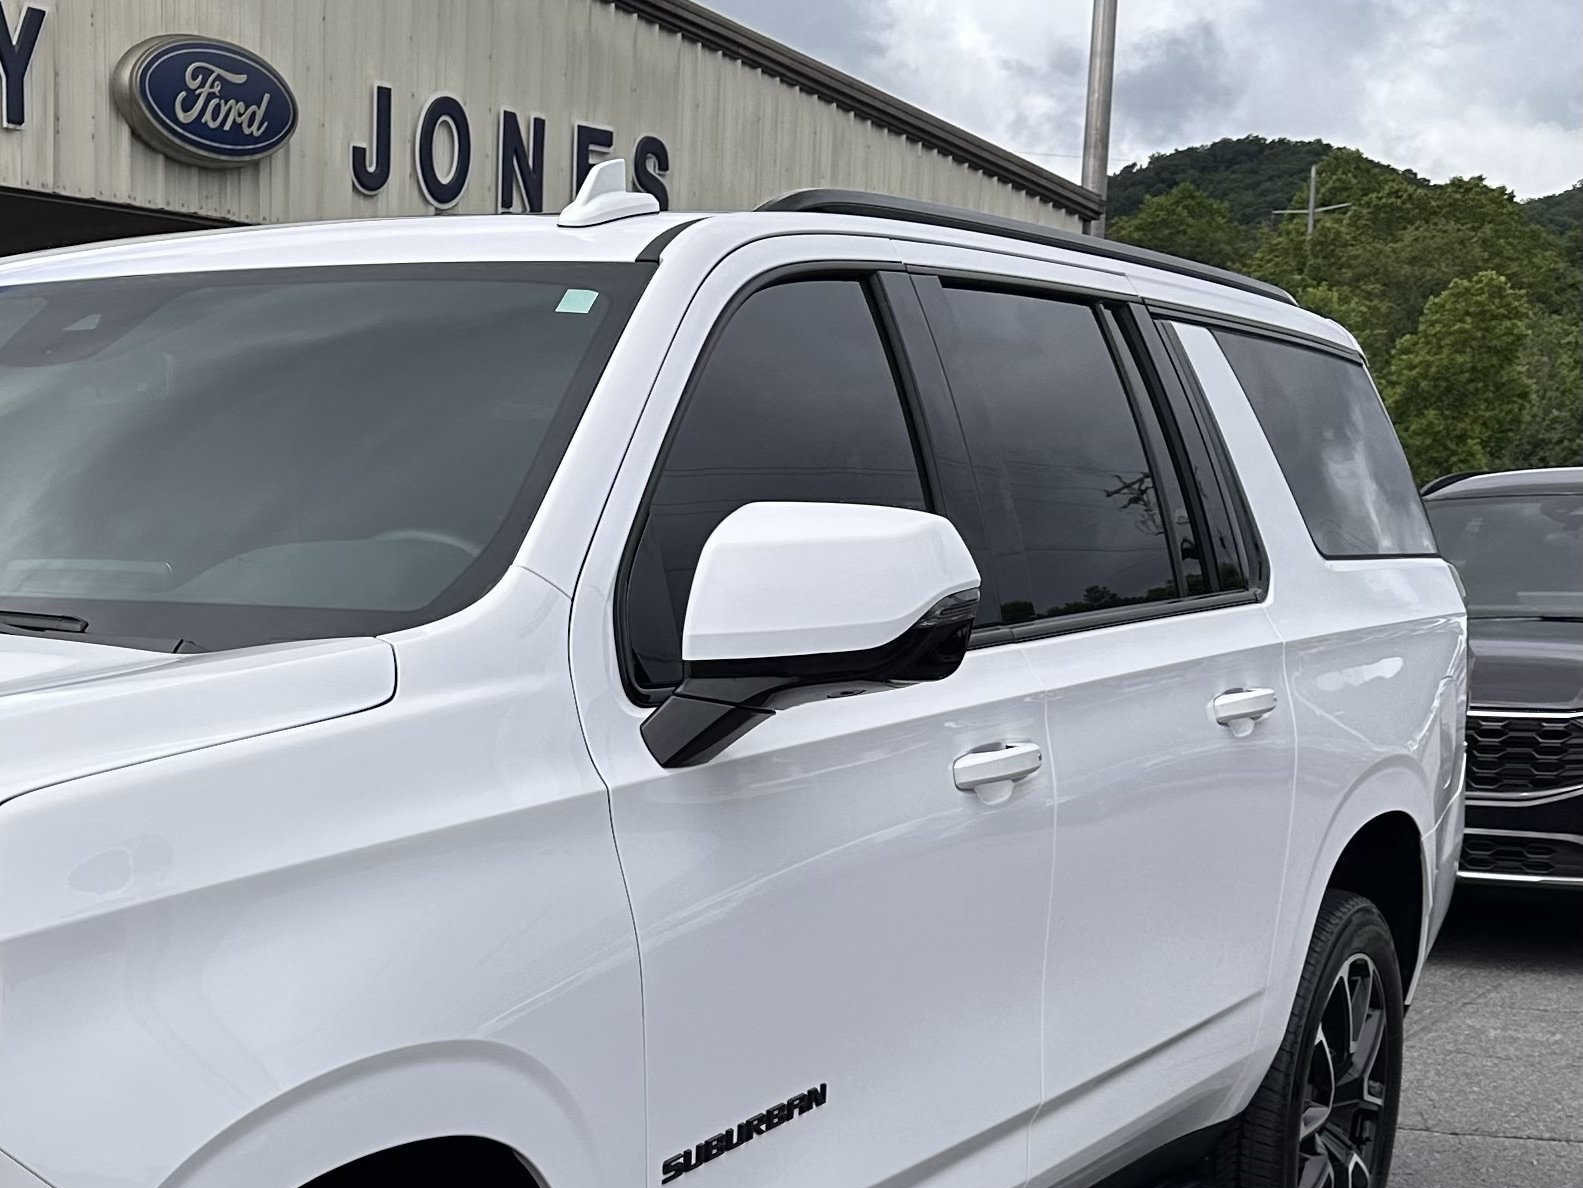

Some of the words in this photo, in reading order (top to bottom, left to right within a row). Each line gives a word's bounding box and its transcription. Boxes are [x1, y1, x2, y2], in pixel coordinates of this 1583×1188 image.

[174, 61, 270, 138] Ford
[351, 84, 670, 213] JONES
[661, 1082, 827, 1185] SUBURBAN
